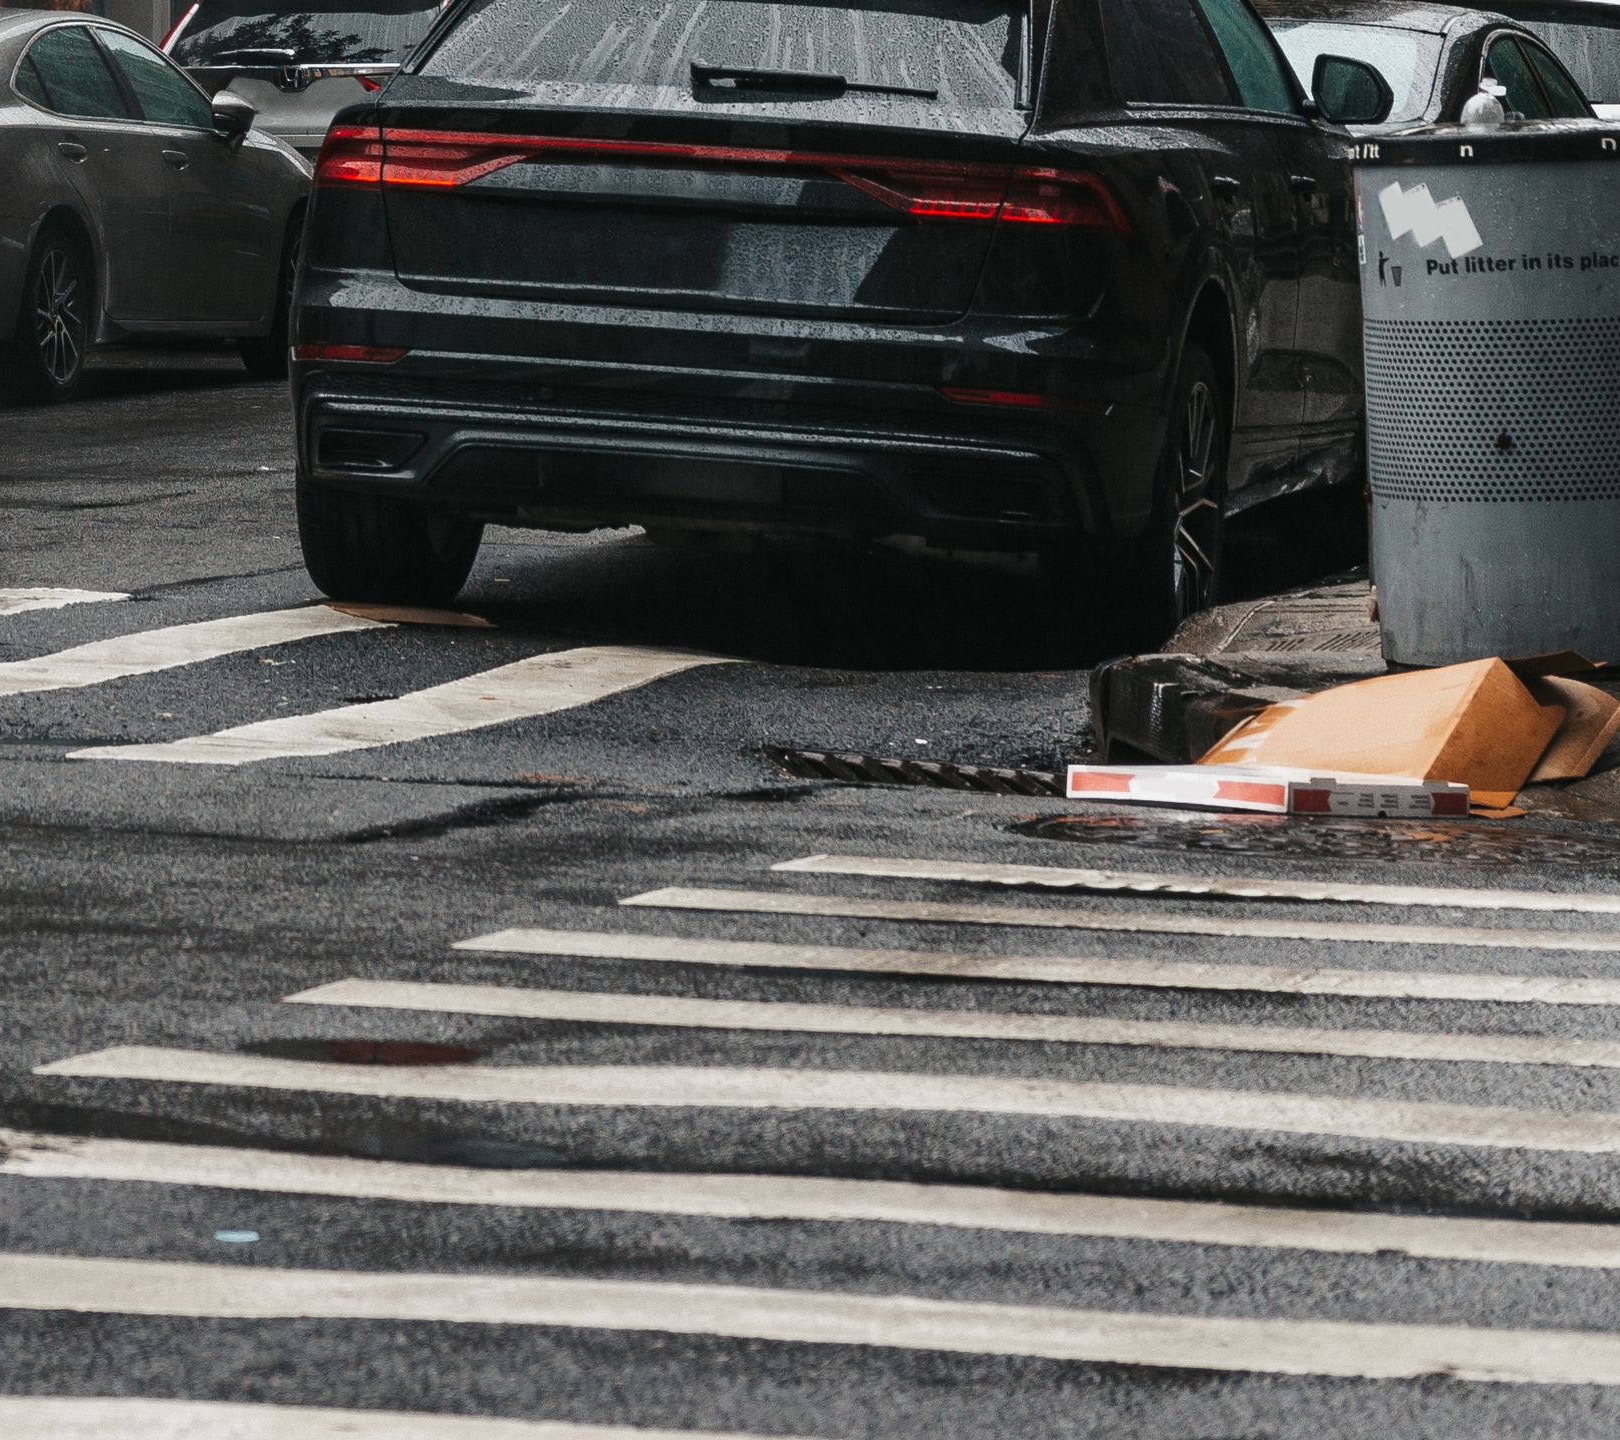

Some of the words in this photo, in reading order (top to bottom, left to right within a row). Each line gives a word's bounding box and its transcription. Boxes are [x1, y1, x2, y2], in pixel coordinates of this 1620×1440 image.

[1426, 258, 1459, 276] Put
[1465, 254, 1516, 274] litter
[1522, 253, 1542, 271] in
[1547, 252, 1574, 270] its
